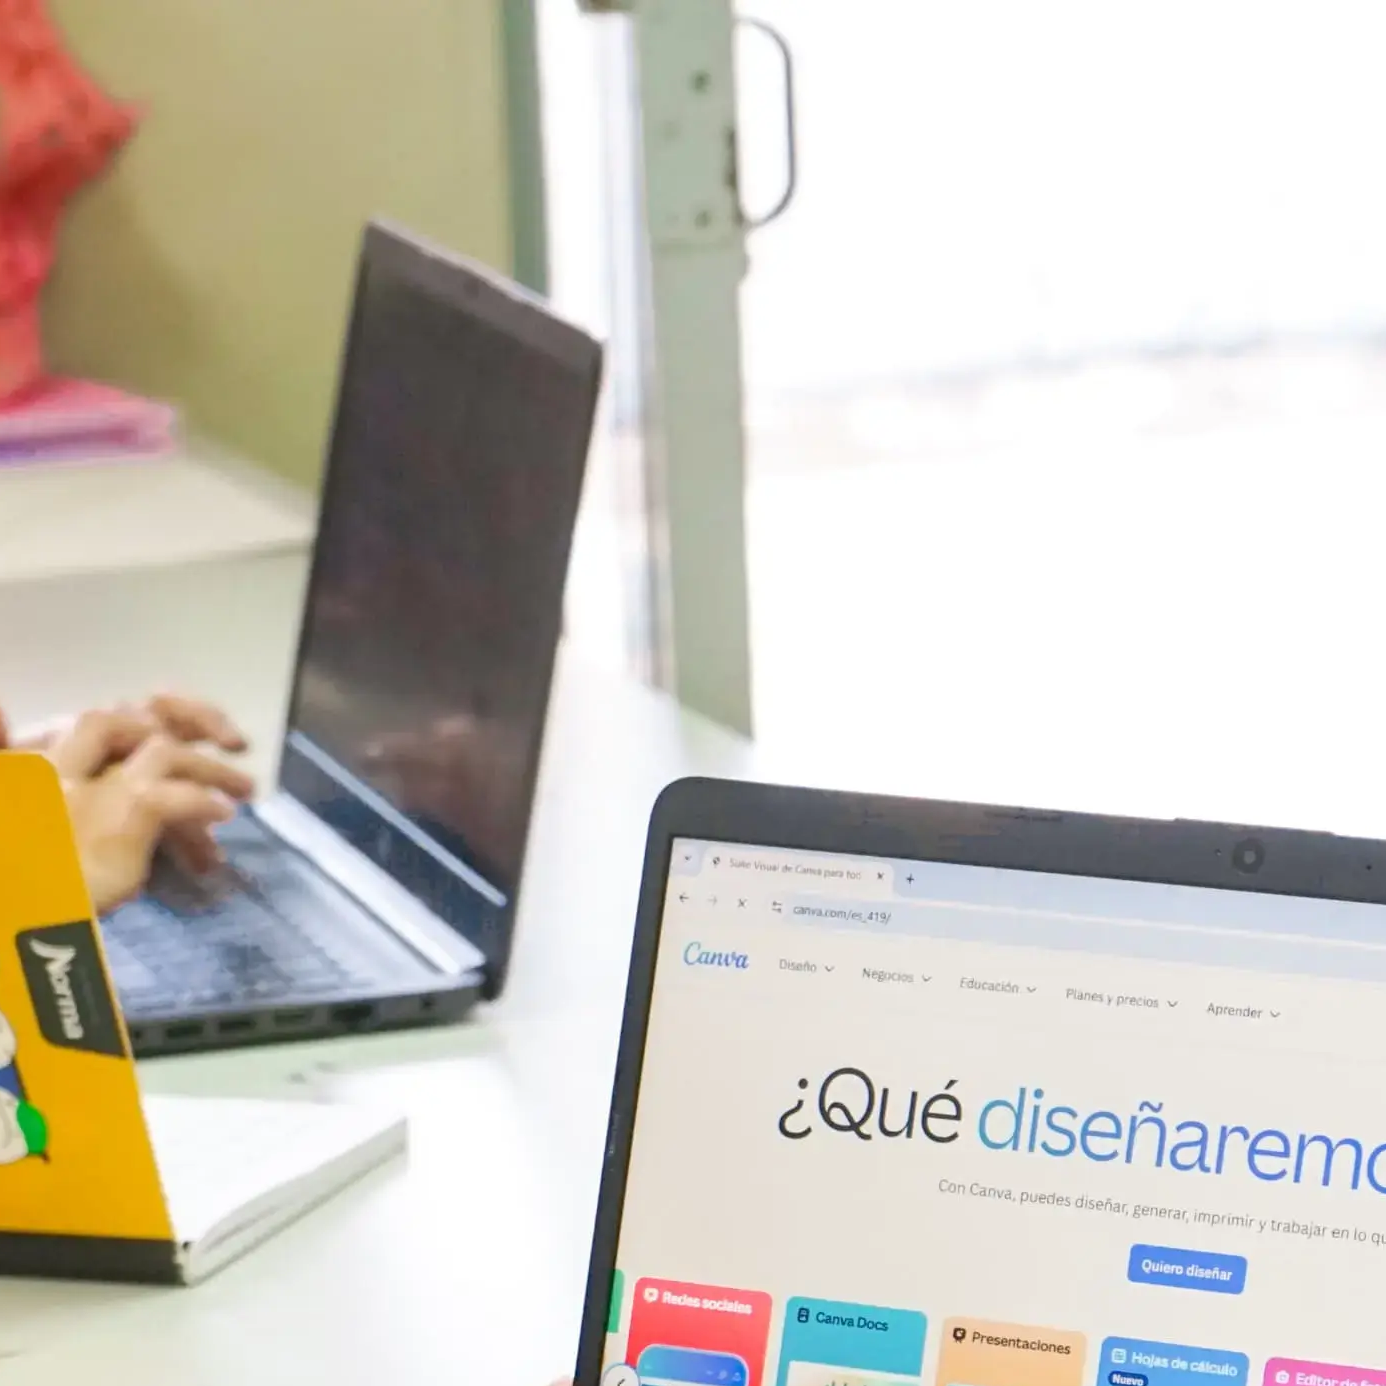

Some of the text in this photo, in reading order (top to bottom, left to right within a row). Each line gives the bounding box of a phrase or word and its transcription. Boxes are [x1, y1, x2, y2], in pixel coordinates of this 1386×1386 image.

[823, 868, 844, 881] para
[793, 904, 891, 925] canva.com/es_419/
[683, 941, 750, 969] Canva
[779, 957, 817, 973] Diseño
[862, 967, 915, 985] Negocios
[959, 976, 1020, 995] Educación
[1066, 987, 1160, 1009] Planes y precios
[1207, 1001, 1264, 1020] Aprender
[776, 1066, 963, 1144] ¿Qué
[938, 1178, 966, 1196] Con
[969, 1182, 1017, 1202] Canva,
[1020, 1189, 1072, 1208] puedes
[1075, 1193, 1130, 1217] diseñar,
[1132, 1203, 1190, 1225] generar,
[1193, 1209, 1255, 1229] imprimir
[1259, 1219, 1267, 1234] y
[1270, 1220, 1328, 1239] trabajar
[1332, 1227, 1350, 1240] en
[1353, 1227, 1367, 1242] lo
[1141, 1259, 1233, 1282] Quiero diseñar
[662, 1290, 753, 1315] Redes sociales
[815, 1311, 889, 1332] Canva Docs
[971, 1331, 1071, 1355] Presentaciones
[1131, 1351, 1238, 1377] Hojas de cálculo
